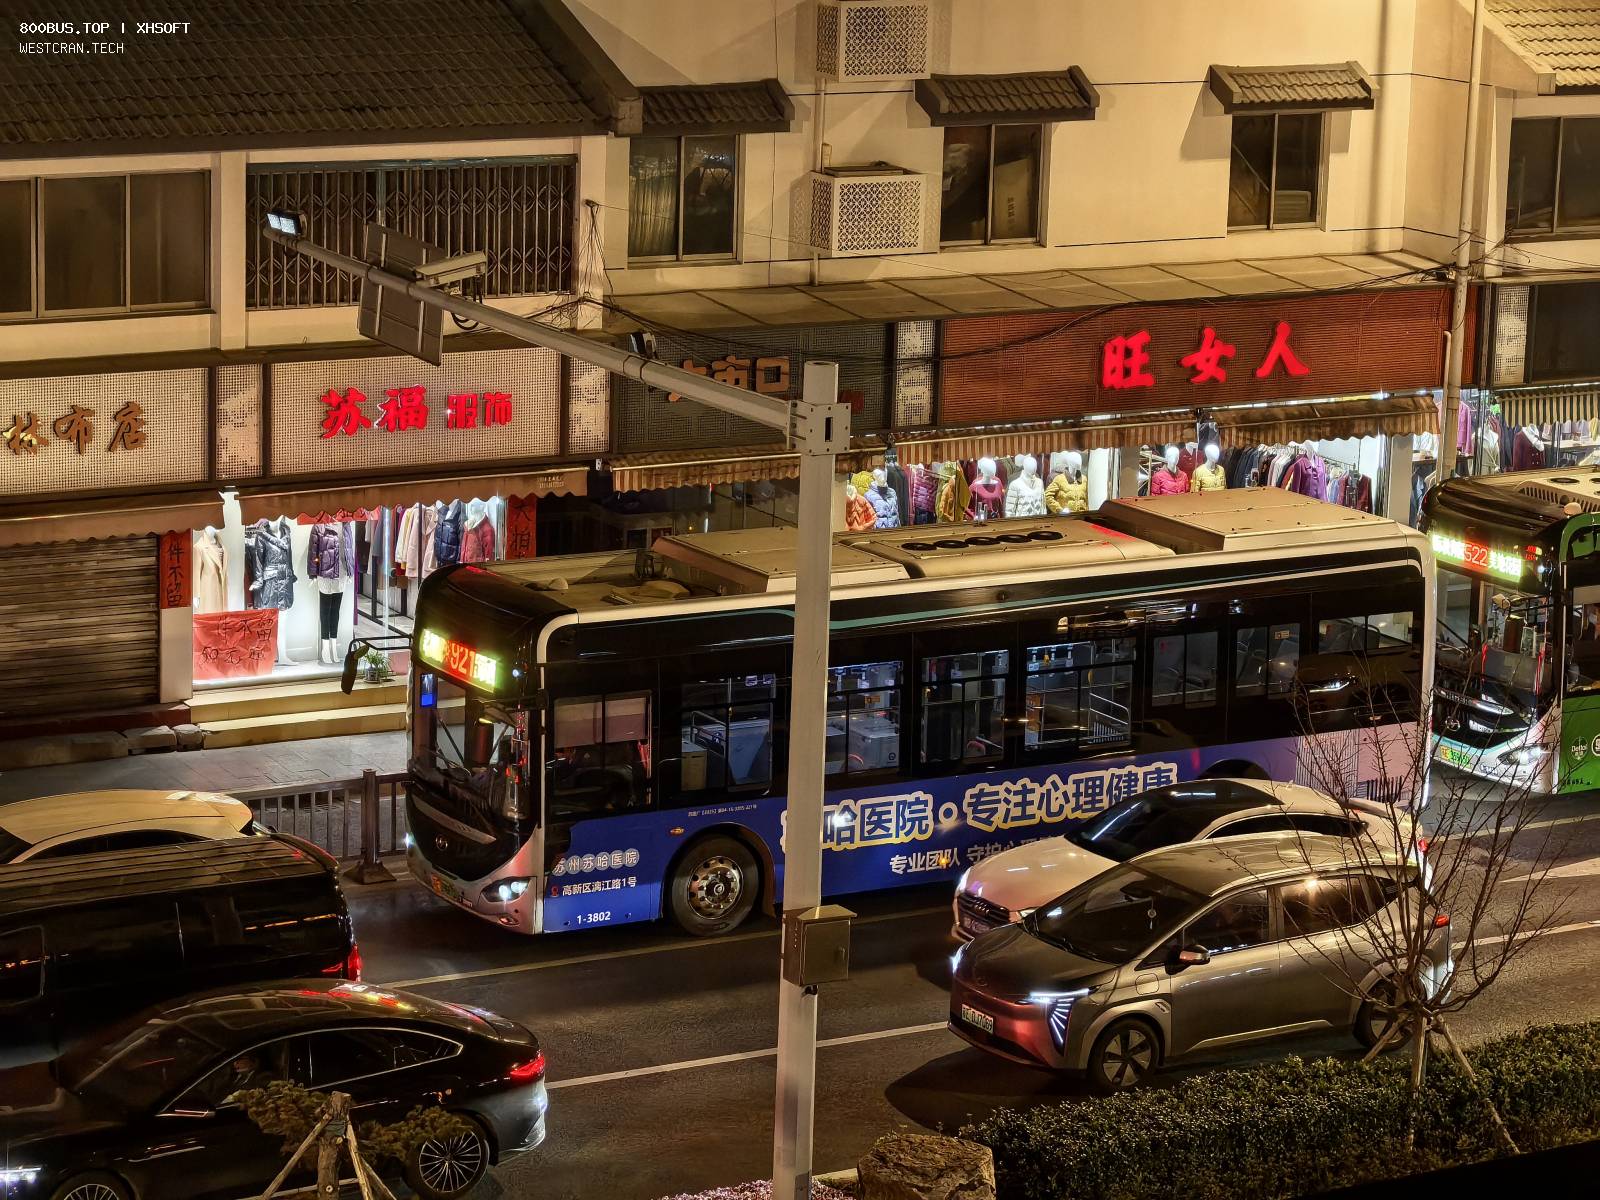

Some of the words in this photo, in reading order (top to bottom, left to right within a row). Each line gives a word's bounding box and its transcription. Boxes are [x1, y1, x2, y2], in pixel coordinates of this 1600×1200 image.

[1102, 320, 1312, 390] 旺女人
[320, 384, 429, 440] 苏福
[577, 911, 611, 925] 1-3802
